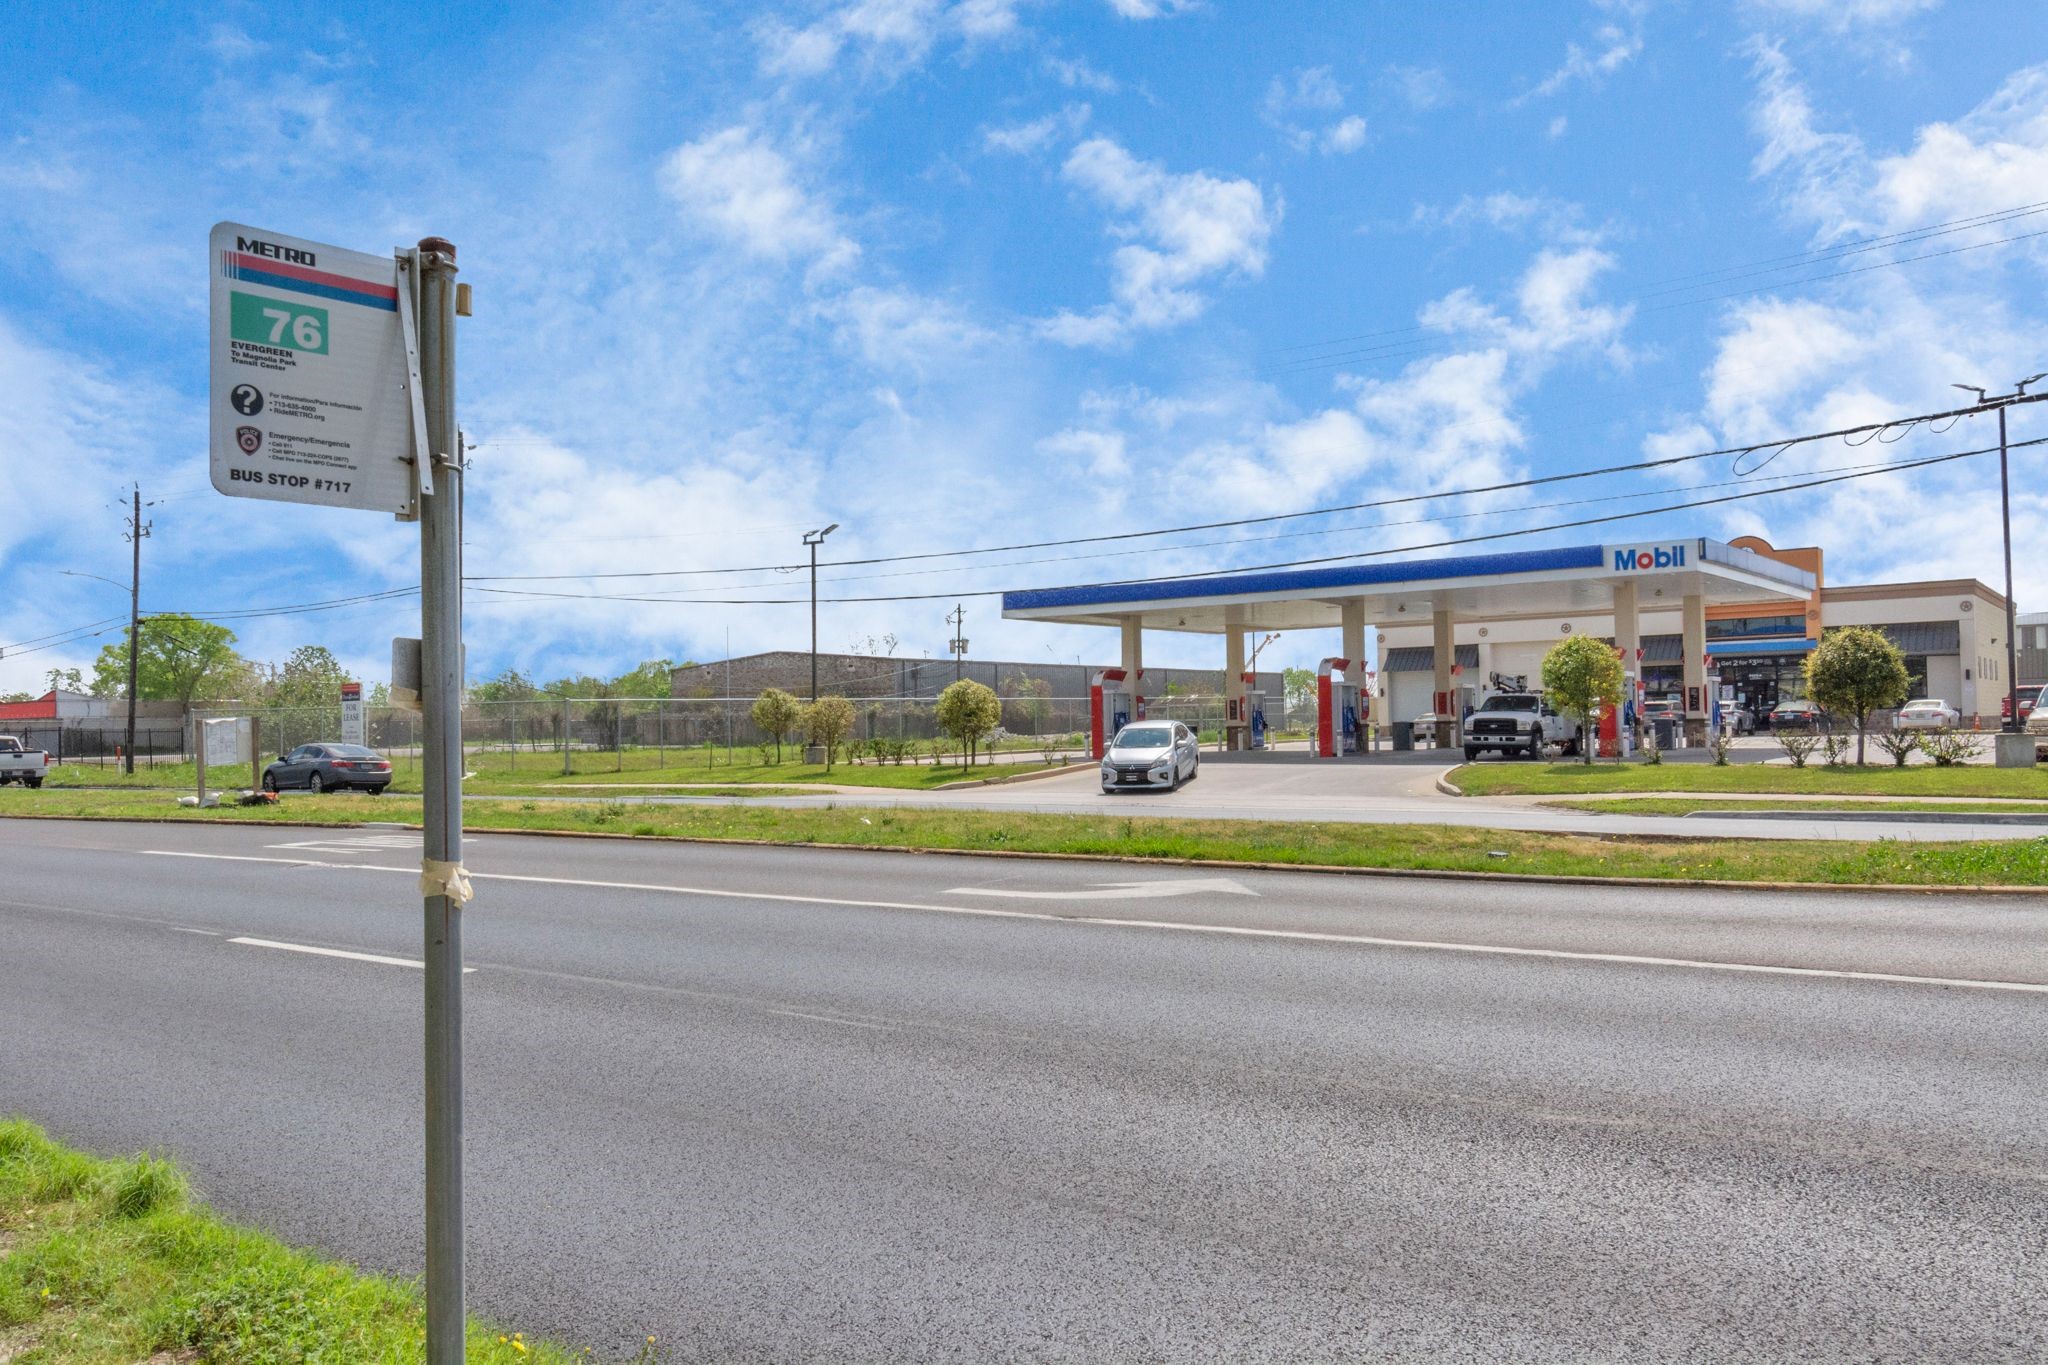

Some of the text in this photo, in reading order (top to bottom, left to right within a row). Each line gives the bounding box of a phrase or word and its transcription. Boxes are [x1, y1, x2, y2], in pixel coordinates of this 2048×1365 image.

[237, 236, 315, 267] METRO
[263, 307, 322, 350] 76
[231, 341, 293, 358] EVERGREEN
[231, 356, 286, 371] Transit Center
[242, 352, 278, 363] Magnolia
[279, 358, 297, 366] Park
[273, 408, 325, 421] RideMETRO.org
[268, 431, 351, 449] Emergency/Emergencia
[230, 468, 351, 493] BUS STOP #717
[1615, 545, 1685, 571] Mobil
[345, 704, 357, 712] FOR
[343, 713, 360, 721] LEASE
